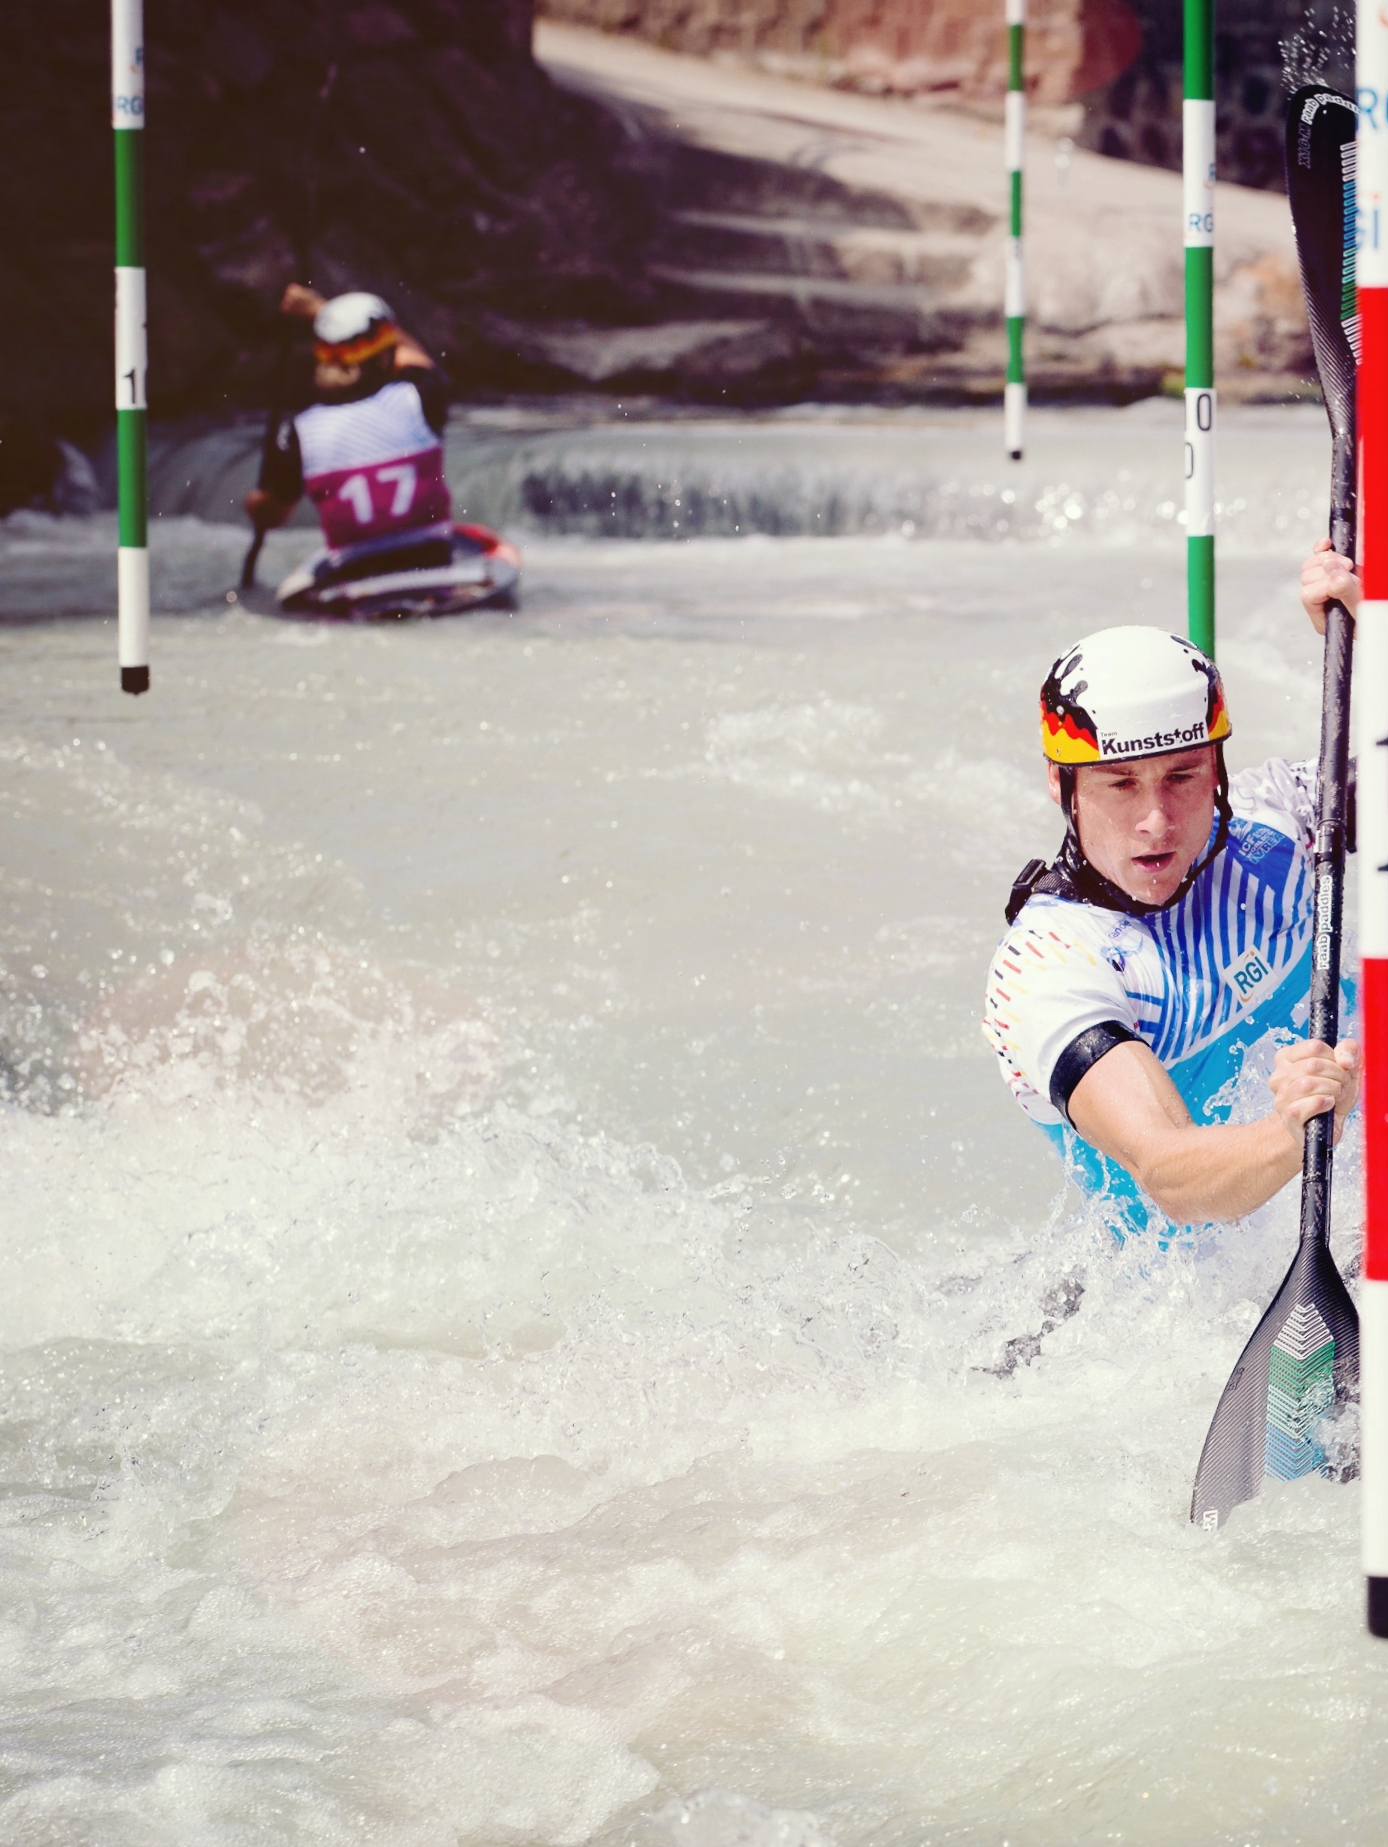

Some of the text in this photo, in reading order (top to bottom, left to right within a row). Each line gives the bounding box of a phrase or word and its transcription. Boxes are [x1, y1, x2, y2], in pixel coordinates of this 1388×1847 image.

[117, 95, 144, 116] RG
[1188, 213, 1214, 233] RG
[338, 463, 418, 525] 17
[1101, 721, 1205, 756] Kunststoff
[1238, 834, 1255, 856] ICF
[1317, 875, 1332, 970] raab paddles
[1233, 955, 1269, 994] RGI
